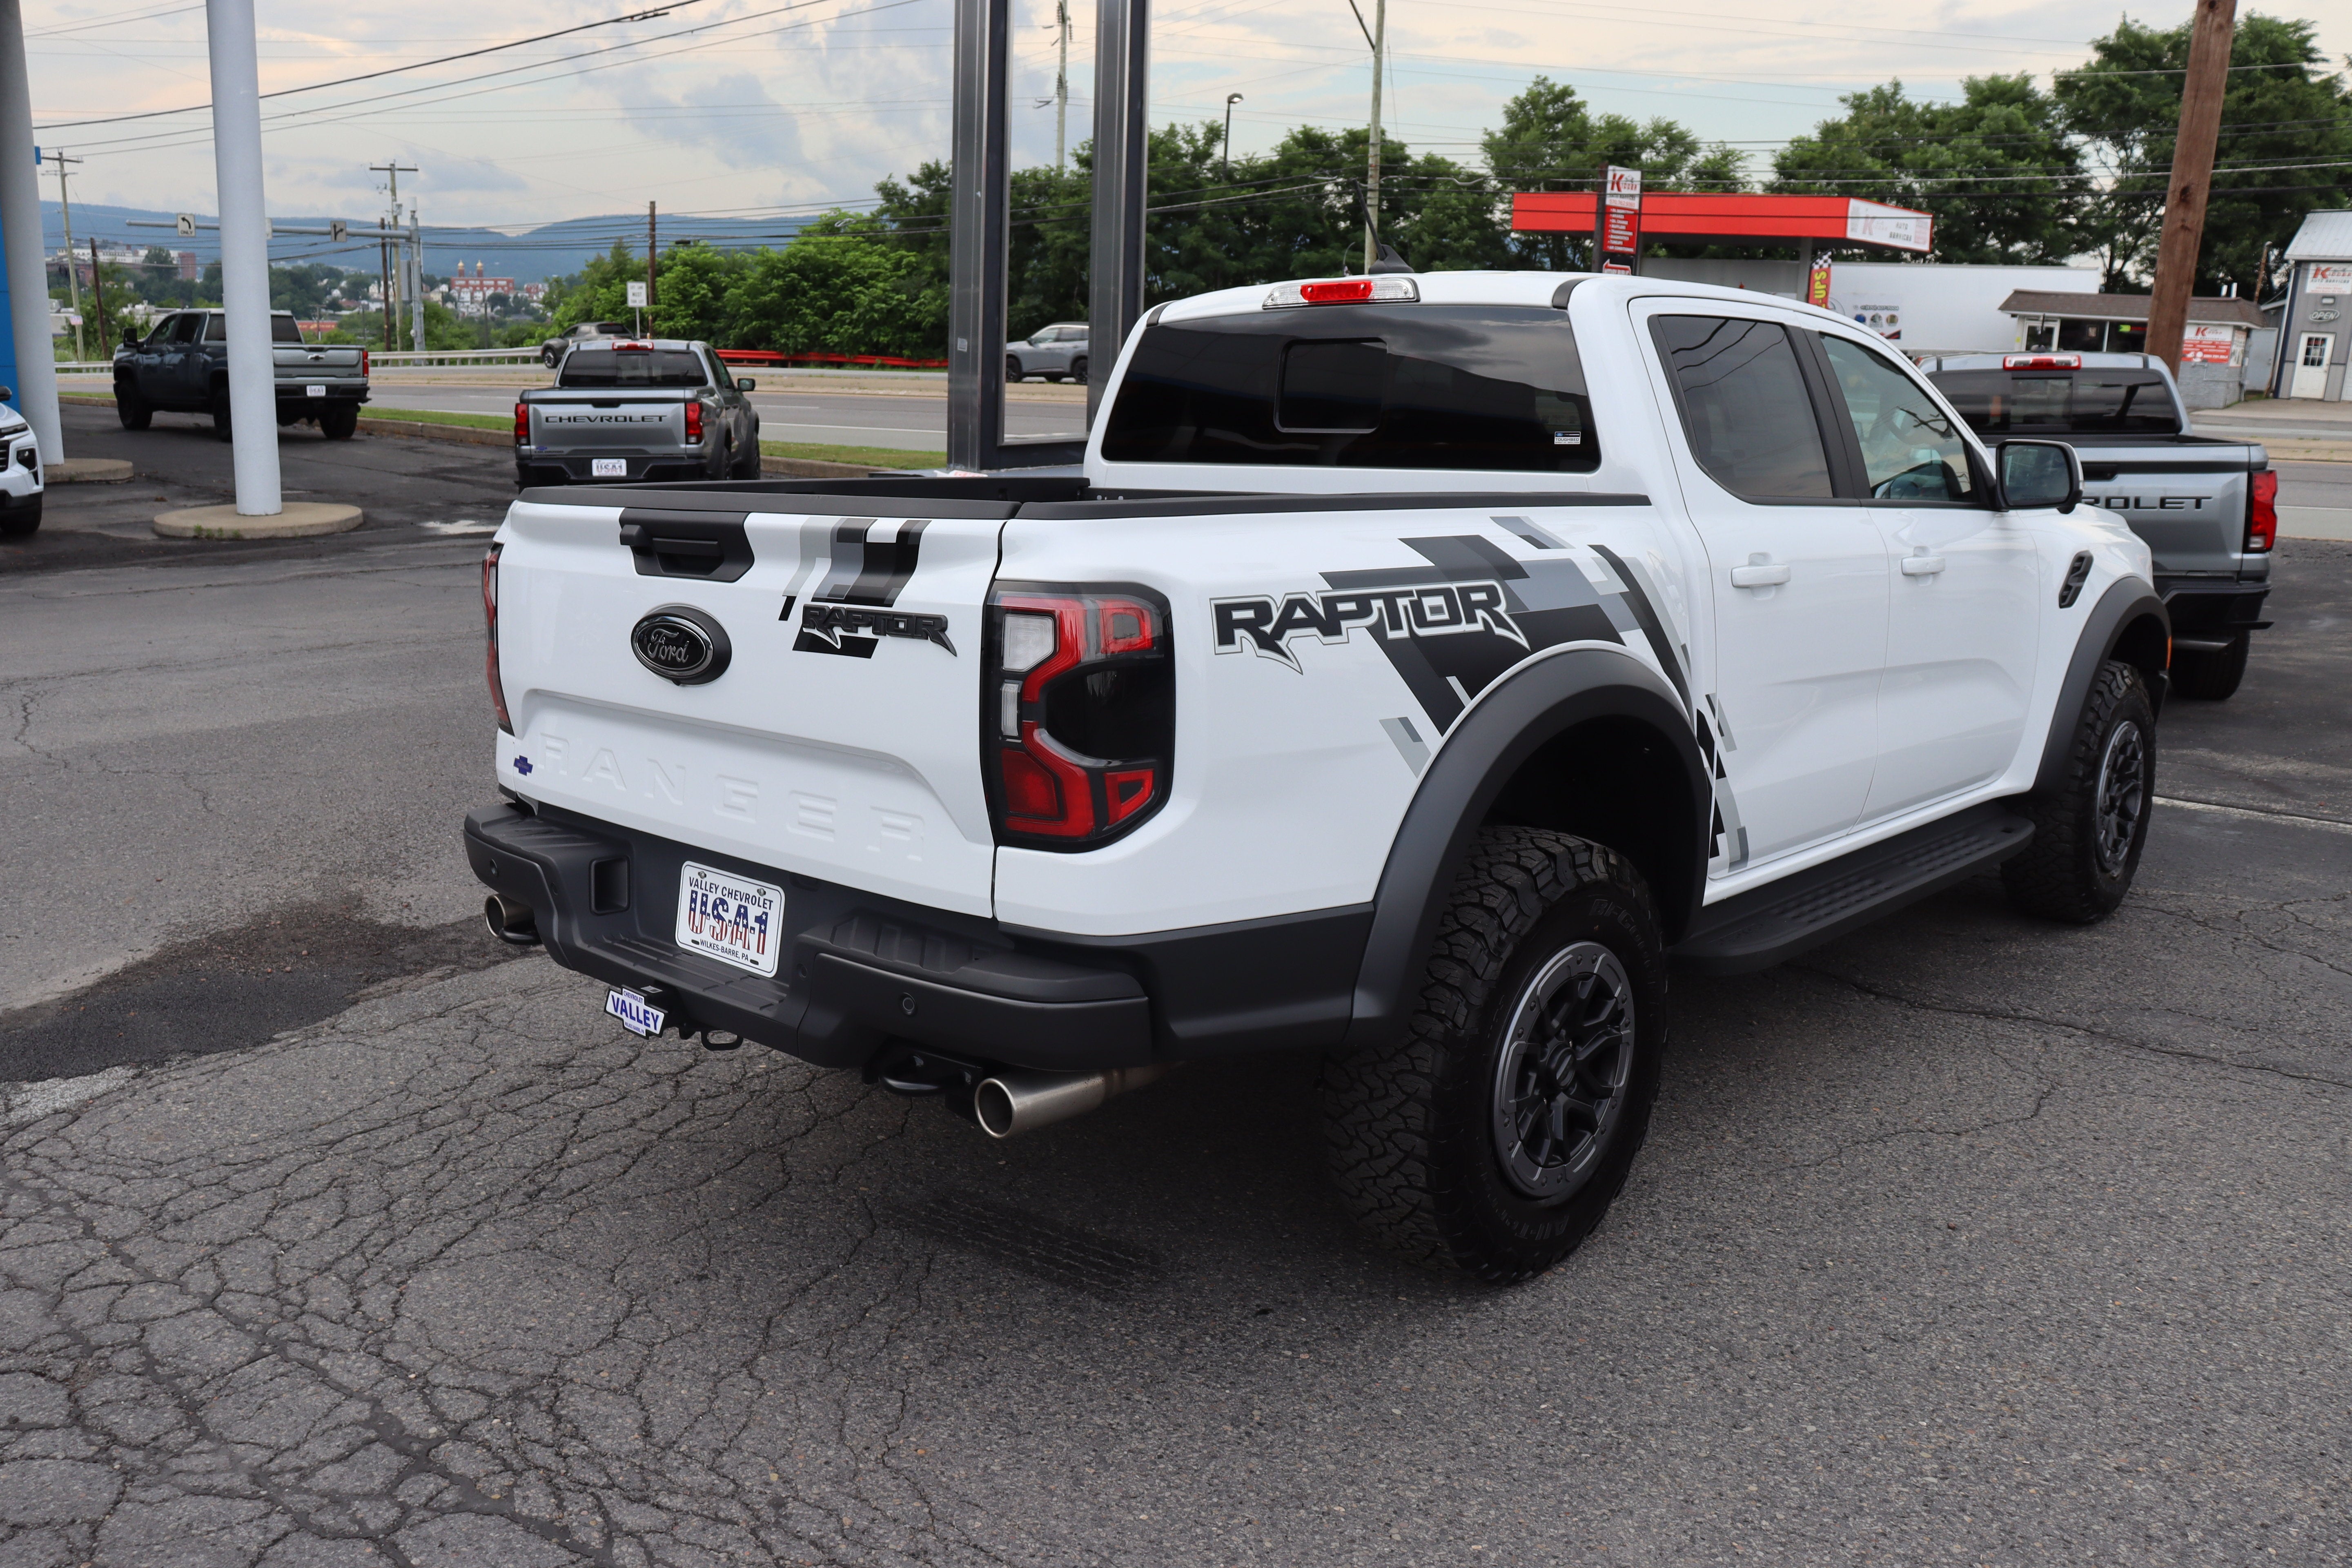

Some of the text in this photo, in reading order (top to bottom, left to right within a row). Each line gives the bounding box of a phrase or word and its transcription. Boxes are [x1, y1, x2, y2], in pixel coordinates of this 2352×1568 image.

[1896, 221, 1908, 230] AUTO
[2313, 267, 2352, 278] KIDDER
[2312, 311, 2336, 320] OPEN
[802, 604, 957, 657] RAPTOR
[1210, 580, 1530, 675] RAPTOR
[647, 628, 690, 663] Ford
[538, 733, 925, 861] RANGER
[689, 876, 774, 911] VALLEY CHEVROLET
[700, 939, 740, 960] WILKES-BARRE,
[611, 994, 659, 1031] VALLEY
[624, 991, 643, 1003] CHEVROLET
